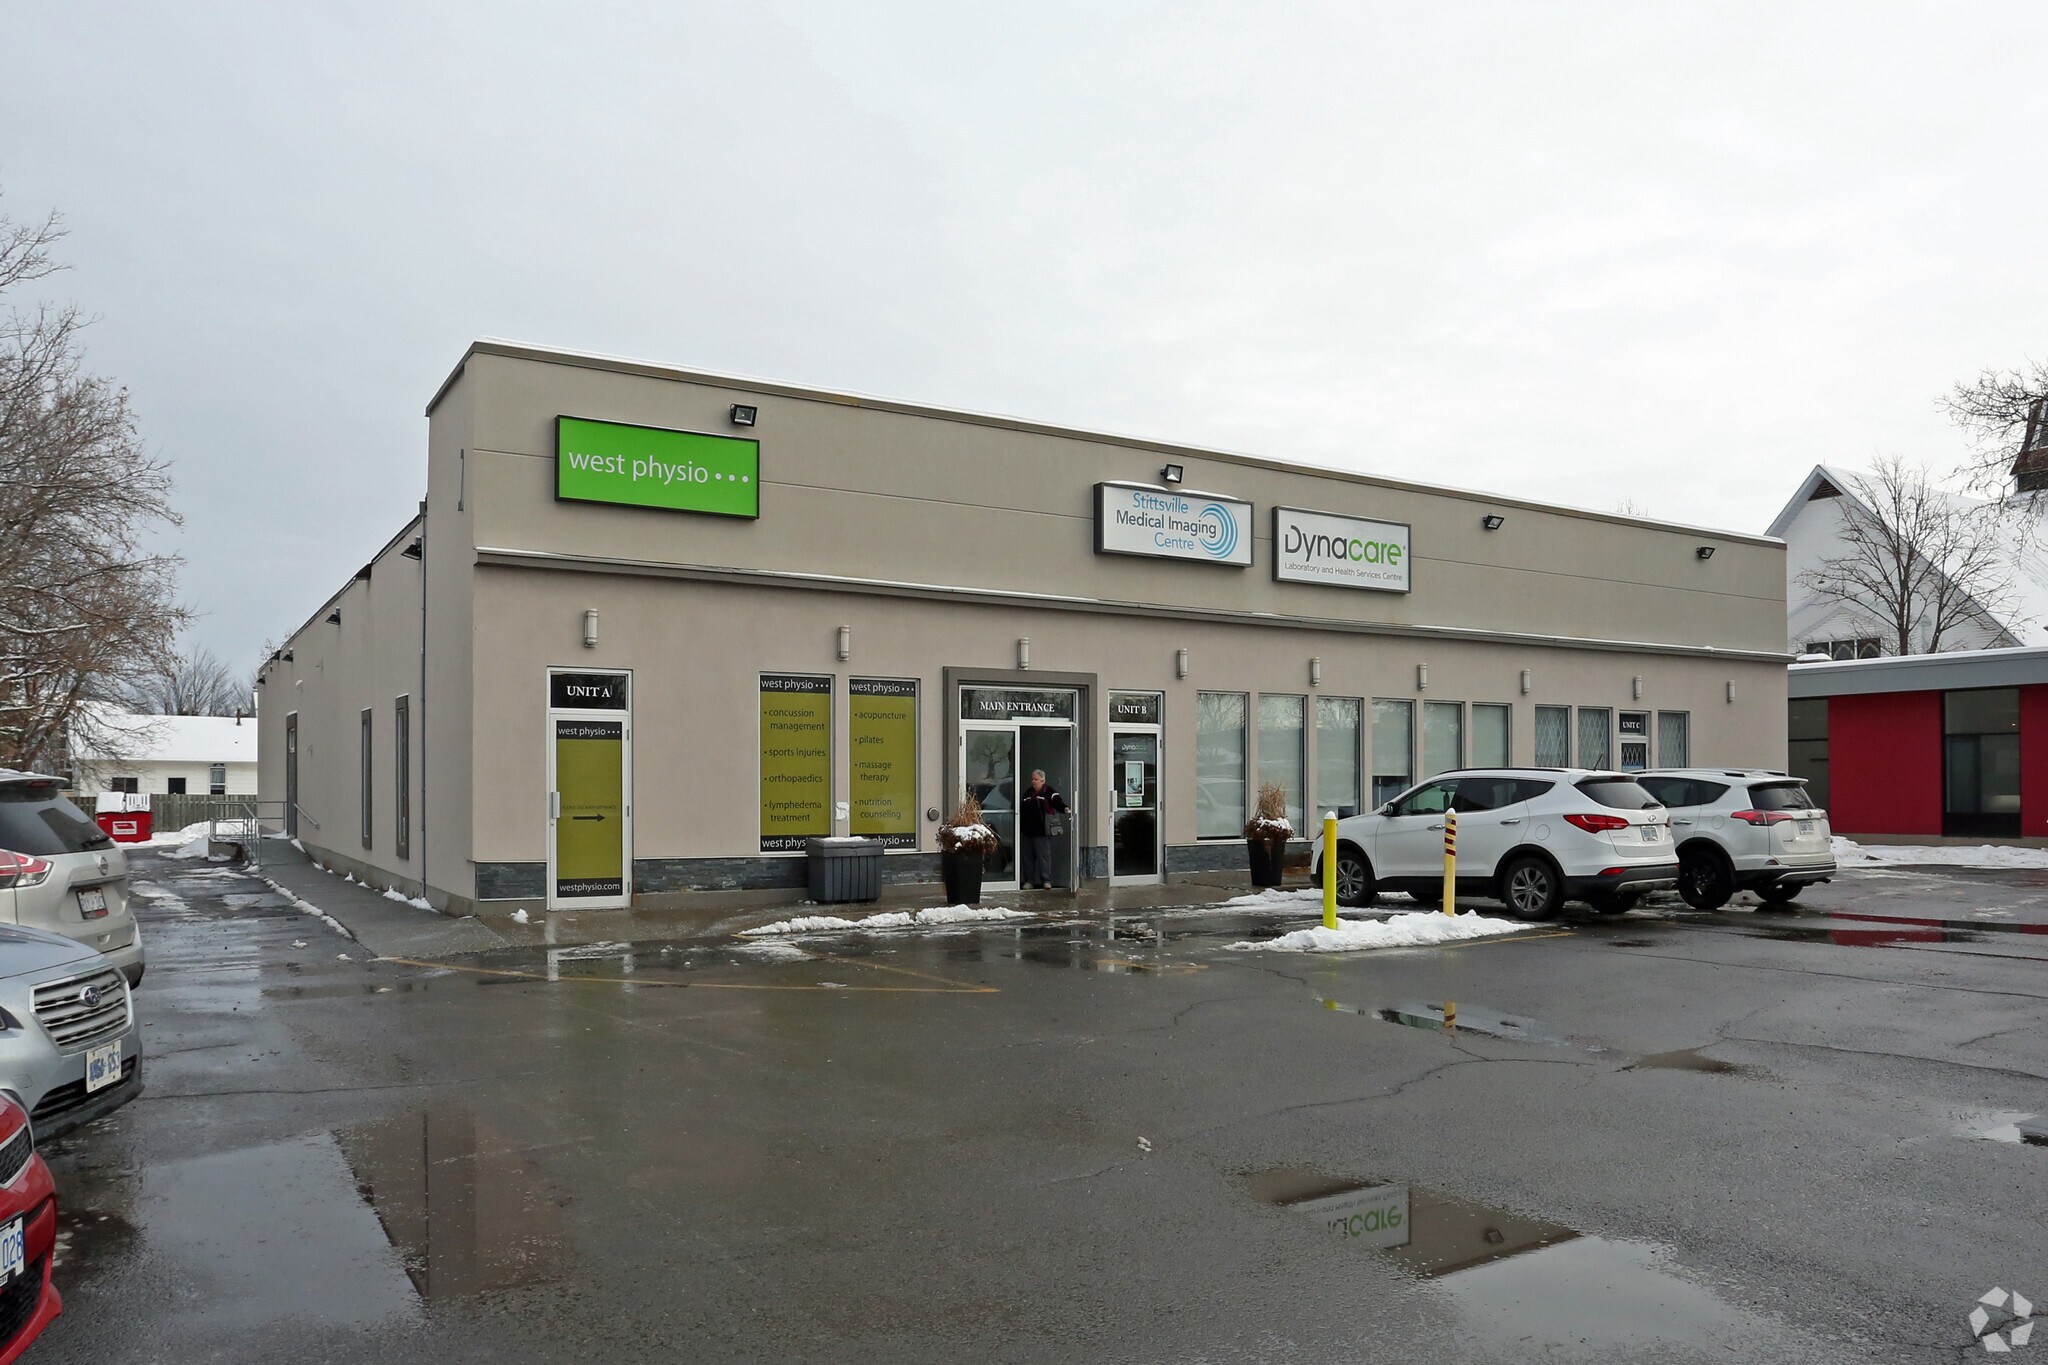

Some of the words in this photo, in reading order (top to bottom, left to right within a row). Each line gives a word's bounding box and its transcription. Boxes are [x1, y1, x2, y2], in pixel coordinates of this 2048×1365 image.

[568, 452, 625, 475] west
[632, 455, 709, 486] physio
[1133, 492, 1189, 514] Stittsville
[1116, 509, 1165, 529] Medical
[1168, 516, 1217, 539] Imaging
[1154, 532, 1195, 550] Centre
[1284, 524, 1402, 566] Dynacare
[1284, 562, 1320, 574] Laboratory
[1321, 566, 1334, 575] and
[1335, 567, 1356, 577] Health
[1356, 569, 1381, 580] Services
[1382, 572, 1403, 582] Centre
[760, 680, 782, 689] west
[785, 681, 814, 691] physio
[851, 683, 871, 692] west
[872, 684, 900, 694] physio
[566, 685, 600, 698] UNIT
[602, 686, 611, 698] A
[980, 701, 1005, 711] MAIN
[1006, 702, 1055, 712] ENTRANCE
[1117, 704, 1140, 714] UNIT
[1141, 705, 1147, 714] B
[768, 708, 815, 718] concussion
[858, 712, 907, 720] acupuncture
[770, 722, 825, 732] management
[1622, 721, 1636, 729] UNIT
[558, 727, 578, 736] west
[579, 727, 606, 738] physio
[858, 735, 884, 745] pilates
[768, 748, 795, 758] sports
[796, 748, 826, 758] injuries
[859, 762, 892, 771] massage
[768, 774, 823, 784] orthopaedics
[860, 773, 890, 783] therapy
[768, 801, 822, 811] lymphedema
[858, 798, 892, 806] nutrition
[770, 814, 811, 822] treatment
[860, 810, 901, 820] counseling
[762, 839, 783, 848] west
[785, 837, 808, 849] phys
[872, 835, 900, 847] hysio
[559, 881, 620, 892] westphysio.com
[2, 1229, 23, 1270] 028
